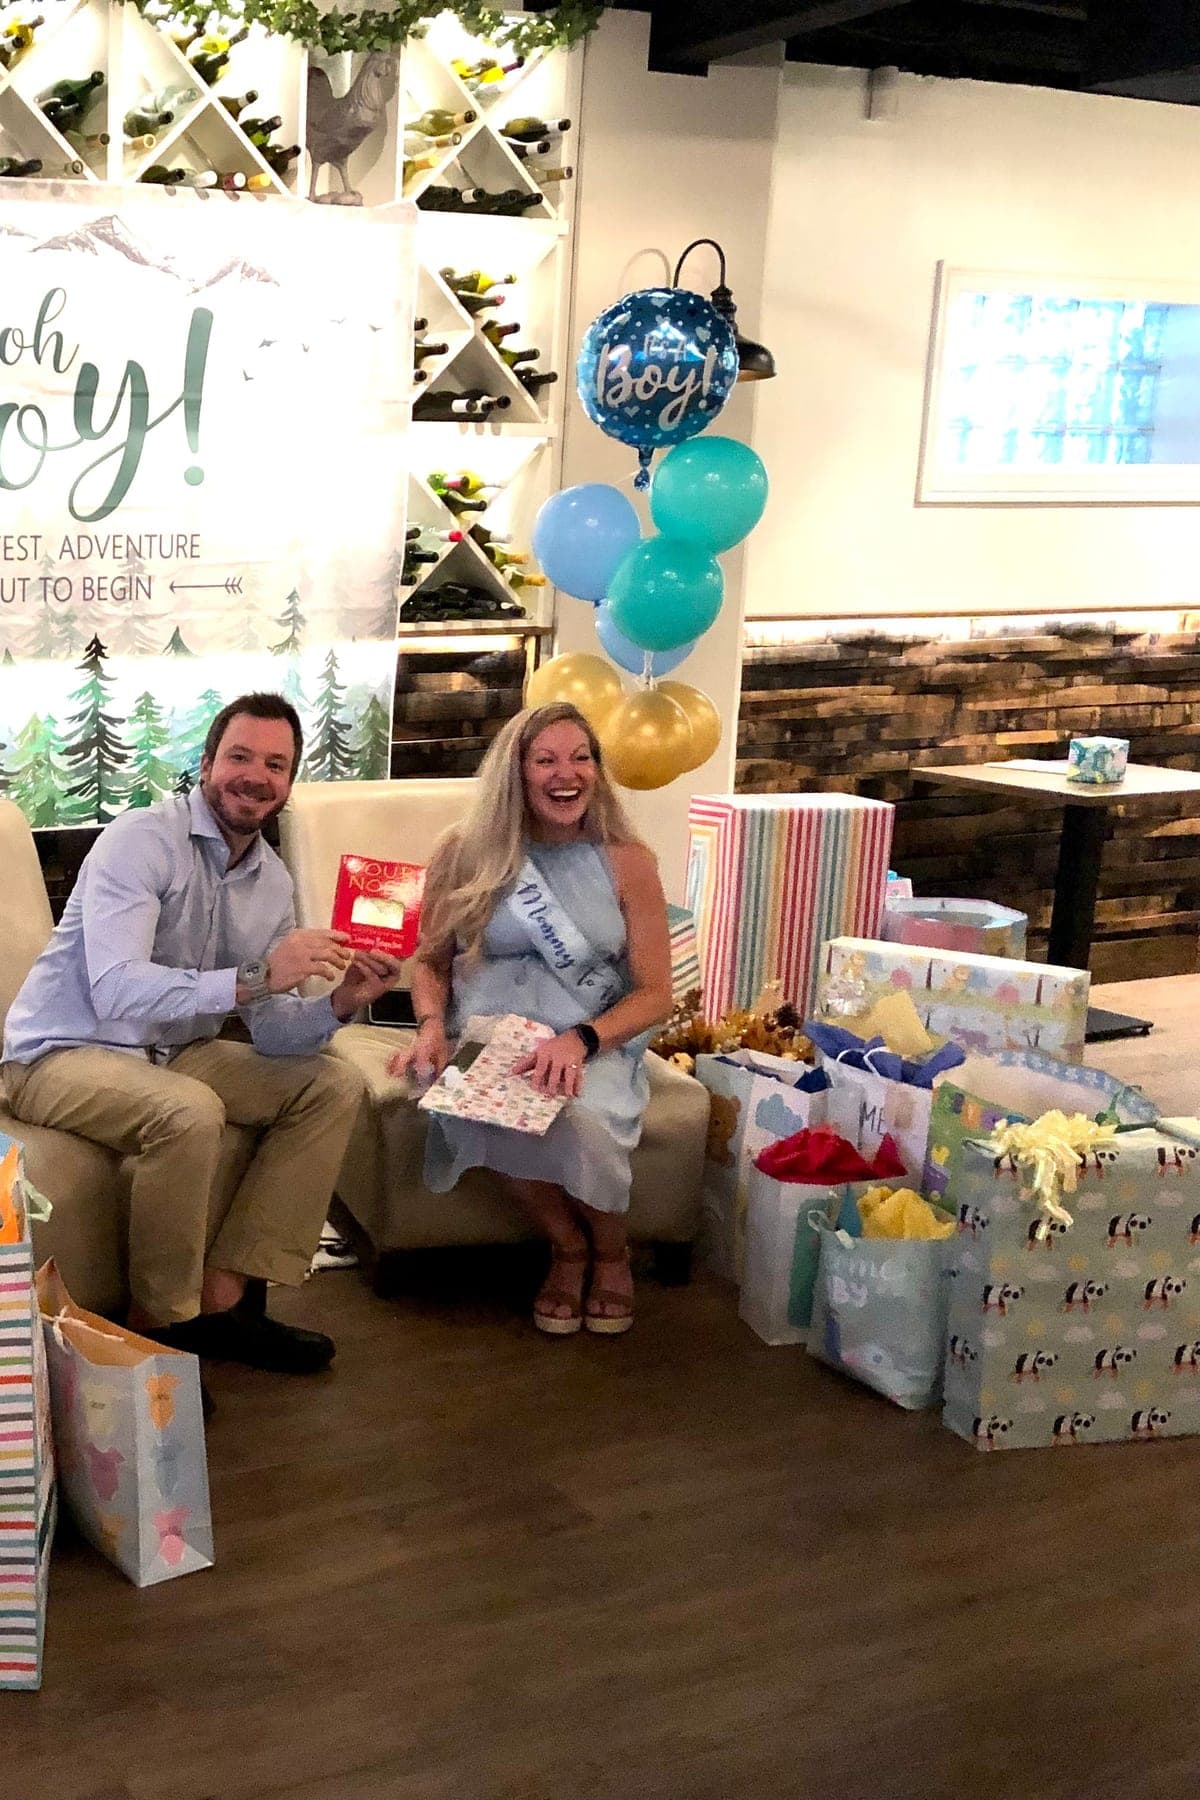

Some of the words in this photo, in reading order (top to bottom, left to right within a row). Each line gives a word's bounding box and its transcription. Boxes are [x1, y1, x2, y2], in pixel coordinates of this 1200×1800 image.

[596, 343, 718, 431] Boy!
[58, 533, 201, 561] ADVENTURE
[38, 575, 73, 602] TO
[82, 574, 152, 602] BEGIN
[517, 880, 575, 970] Mommy
